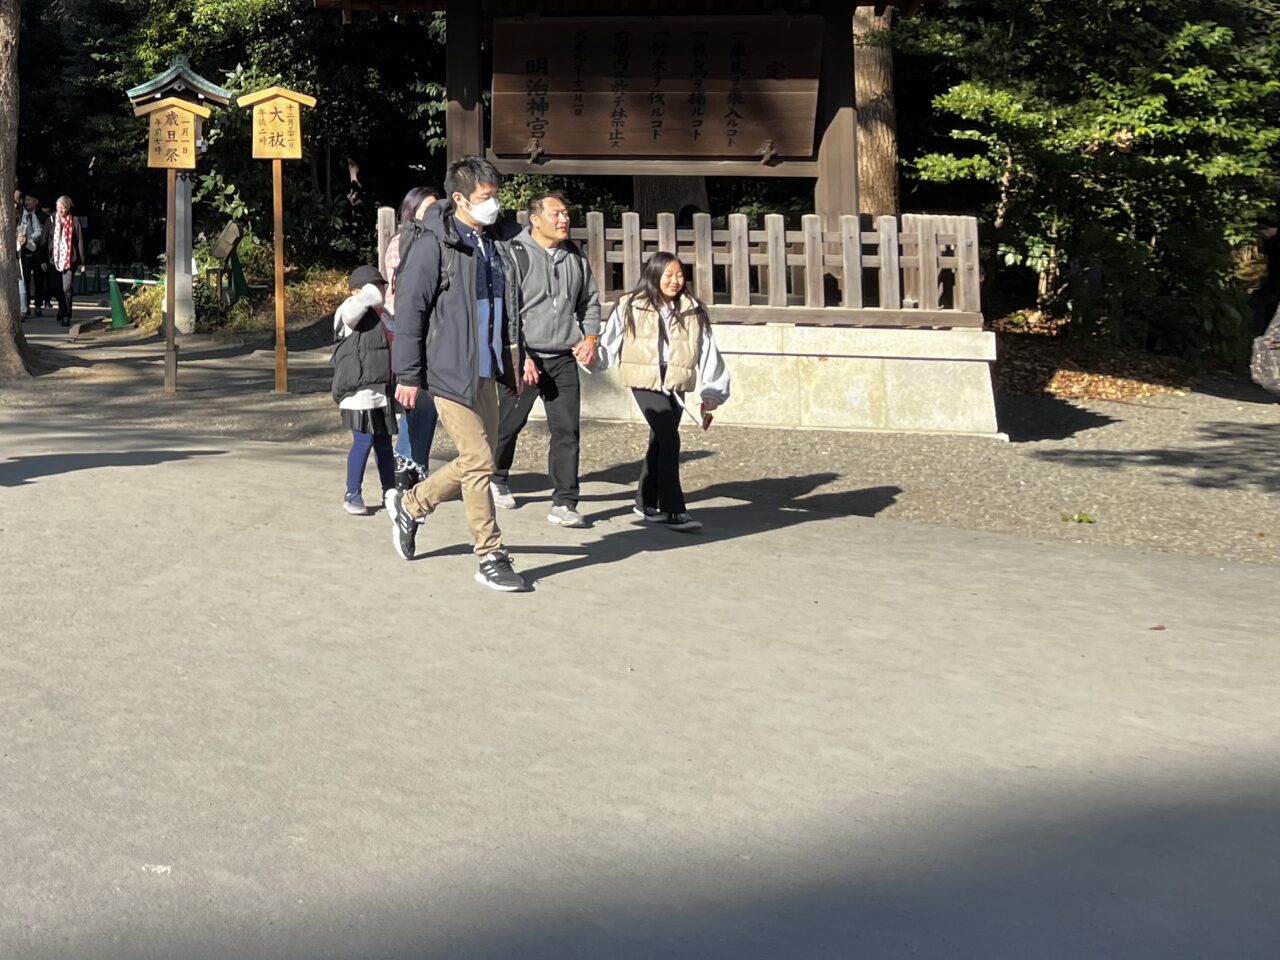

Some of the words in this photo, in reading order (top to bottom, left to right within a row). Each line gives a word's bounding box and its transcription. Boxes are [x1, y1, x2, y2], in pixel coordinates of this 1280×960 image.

[525, 57, 551, 140] 明治神宮
[153, 118, 163, 155] 午前七時
[164, 110, 180, 163] 歳旦祭
[181, 120, 190, 154] 一月一日
[258, 108, 268, 146] 午後二時
[268, 106, 286, 148] 大祓
